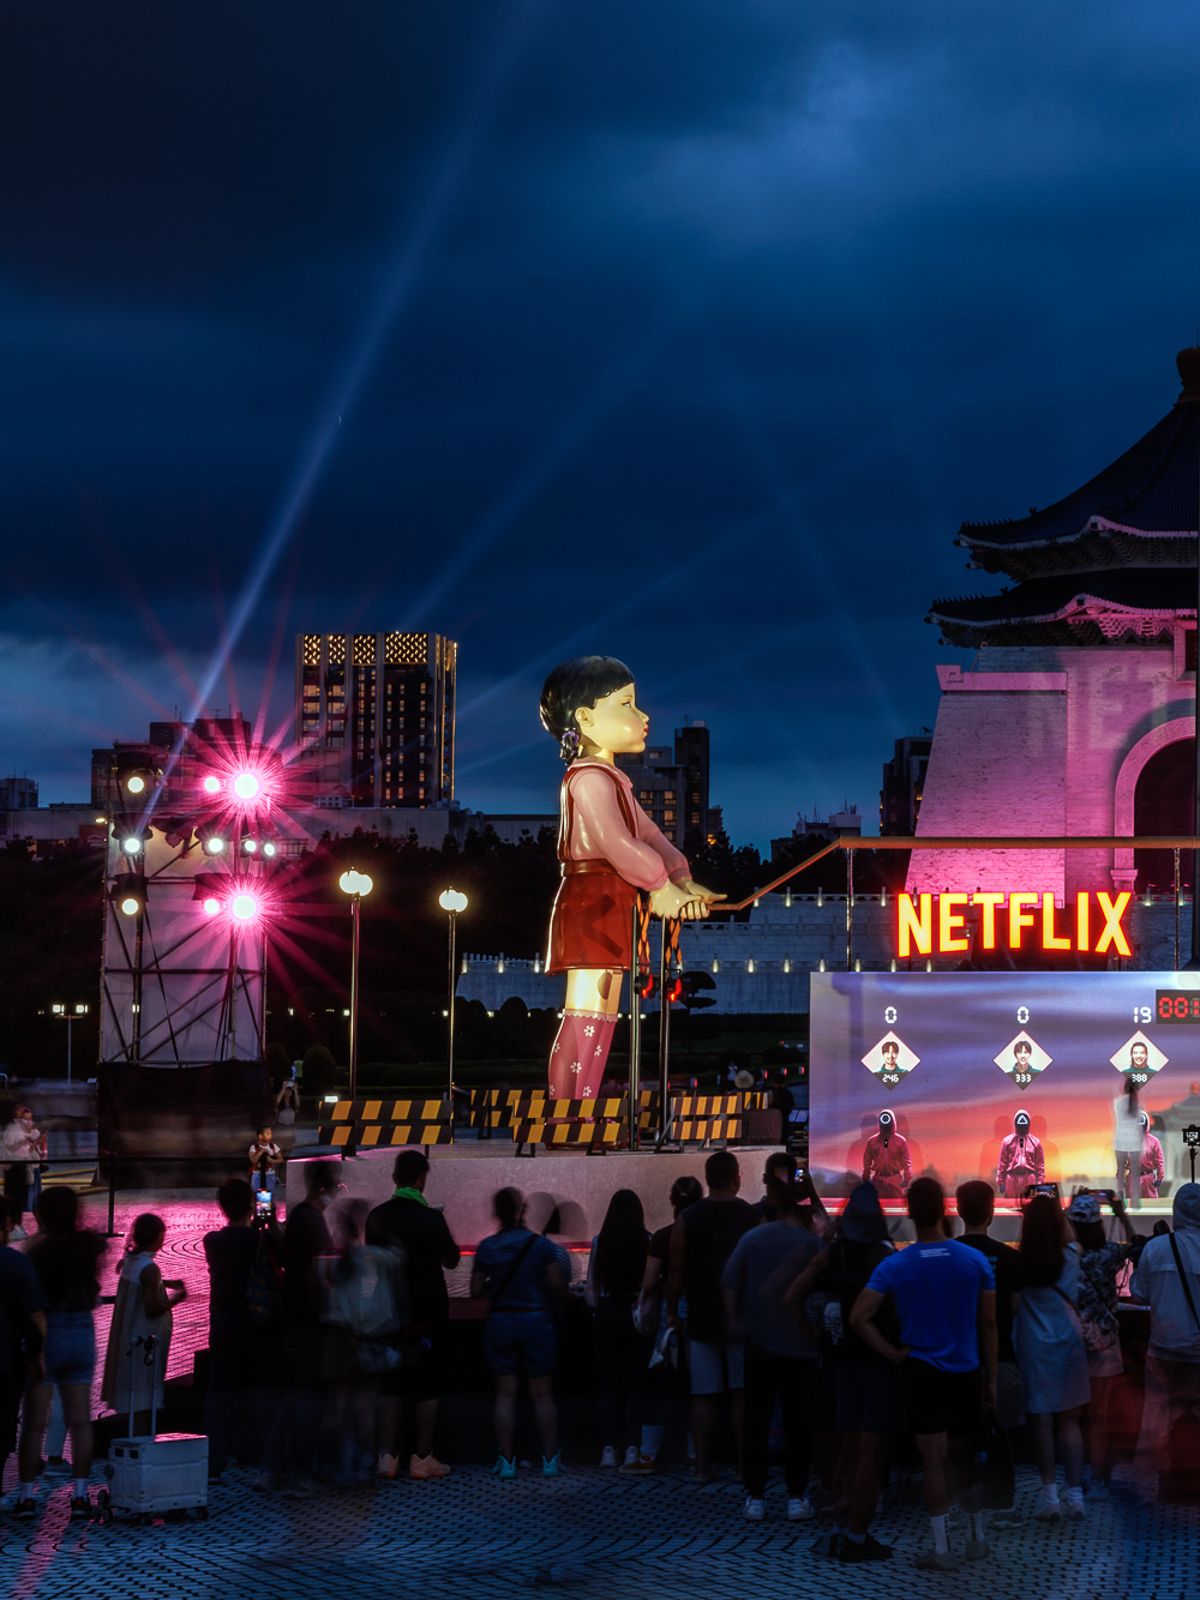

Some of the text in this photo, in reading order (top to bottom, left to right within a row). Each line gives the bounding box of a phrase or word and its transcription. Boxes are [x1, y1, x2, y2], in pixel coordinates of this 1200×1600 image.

[897, 891, 1133, 958] NETFLIX
[885, 1006, 897, 1024] 0
[1017, 1006, 1029, 1024] 0
[1133, 1006, 1152, 1024] 19
[882, 1073, 900, 1083] 246
[1015, 1073, 1032, 1083] 333
